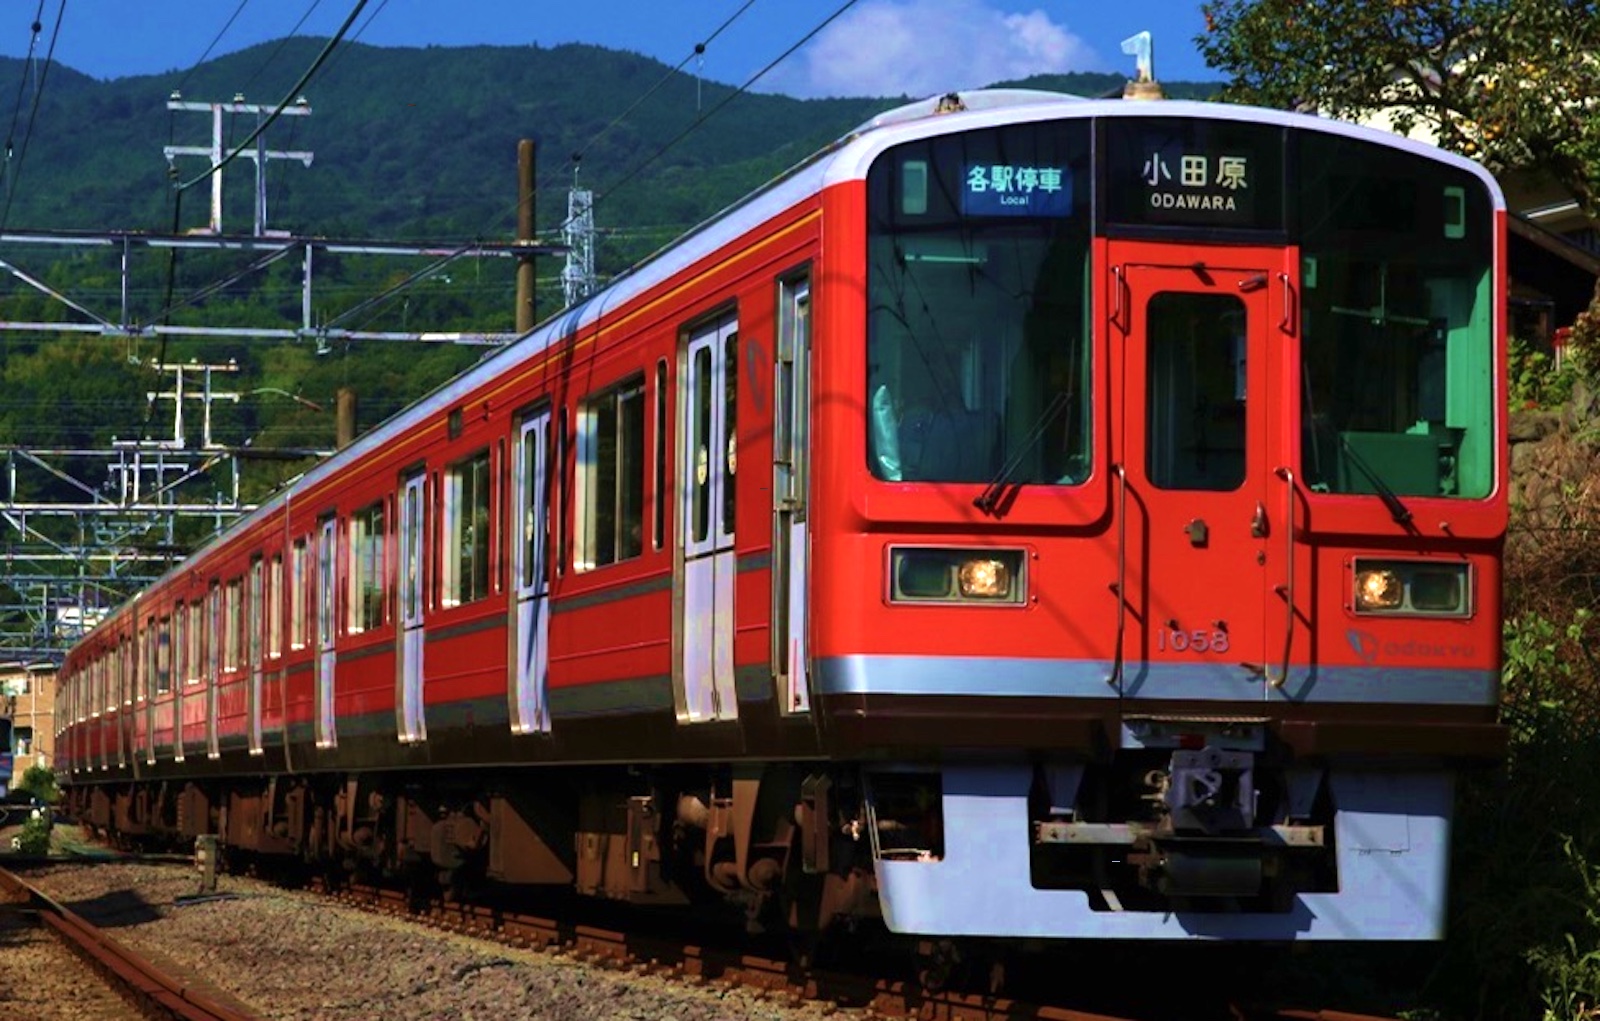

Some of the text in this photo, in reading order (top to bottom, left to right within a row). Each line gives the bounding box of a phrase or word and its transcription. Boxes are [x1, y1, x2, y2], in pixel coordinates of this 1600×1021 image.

[967, 165, 1062, 193] 各駅停車
[1143, 152, 1248, 189] 小田原
[1000, 195, 1029, 205] Local
[1151, 192, 1236, 211] ODAWARA
[1157, 629, 1230, 652] 1058
